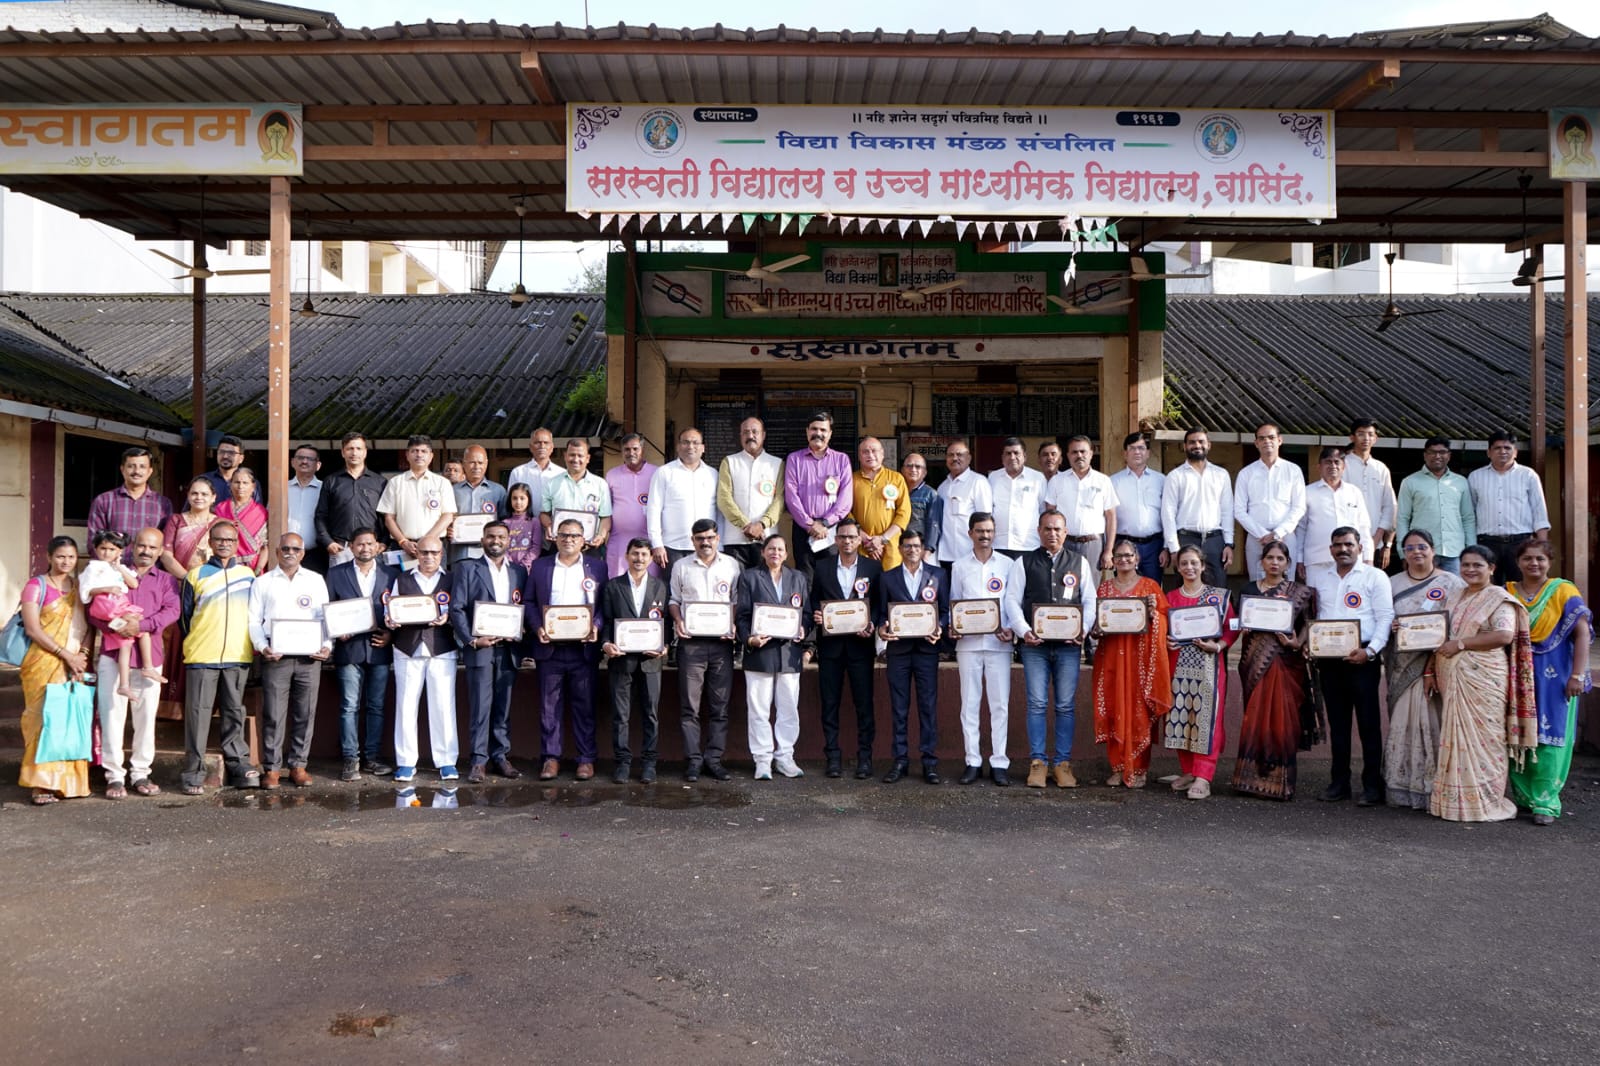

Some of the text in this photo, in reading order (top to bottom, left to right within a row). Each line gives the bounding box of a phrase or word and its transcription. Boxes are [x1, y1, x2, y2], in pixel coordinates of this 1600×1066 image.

[0, 108, 251, 147] स्वागतम
[865, 111, 885, 123] नहि
[888, 110, 917, 123] ज्ञानेन
[920, 110, 948, 127] सदृशं
[951, 111, 999, 124] पवित्रमिह
[1002, 111, 1033, 124] विद्यते
[776, 131, 1116, 153] विद्या विकास मंडळ संचलित
[586, 158, 701, 199] सरस्वती
[709, 159, 826, 199] विद्यालय
[834, 168, 857, 199] व
[866, 167, 932, 199] उच्च
[939, 160, 1075, 200] माध्यमिक
[844, 292, 877, 311] उच्च
